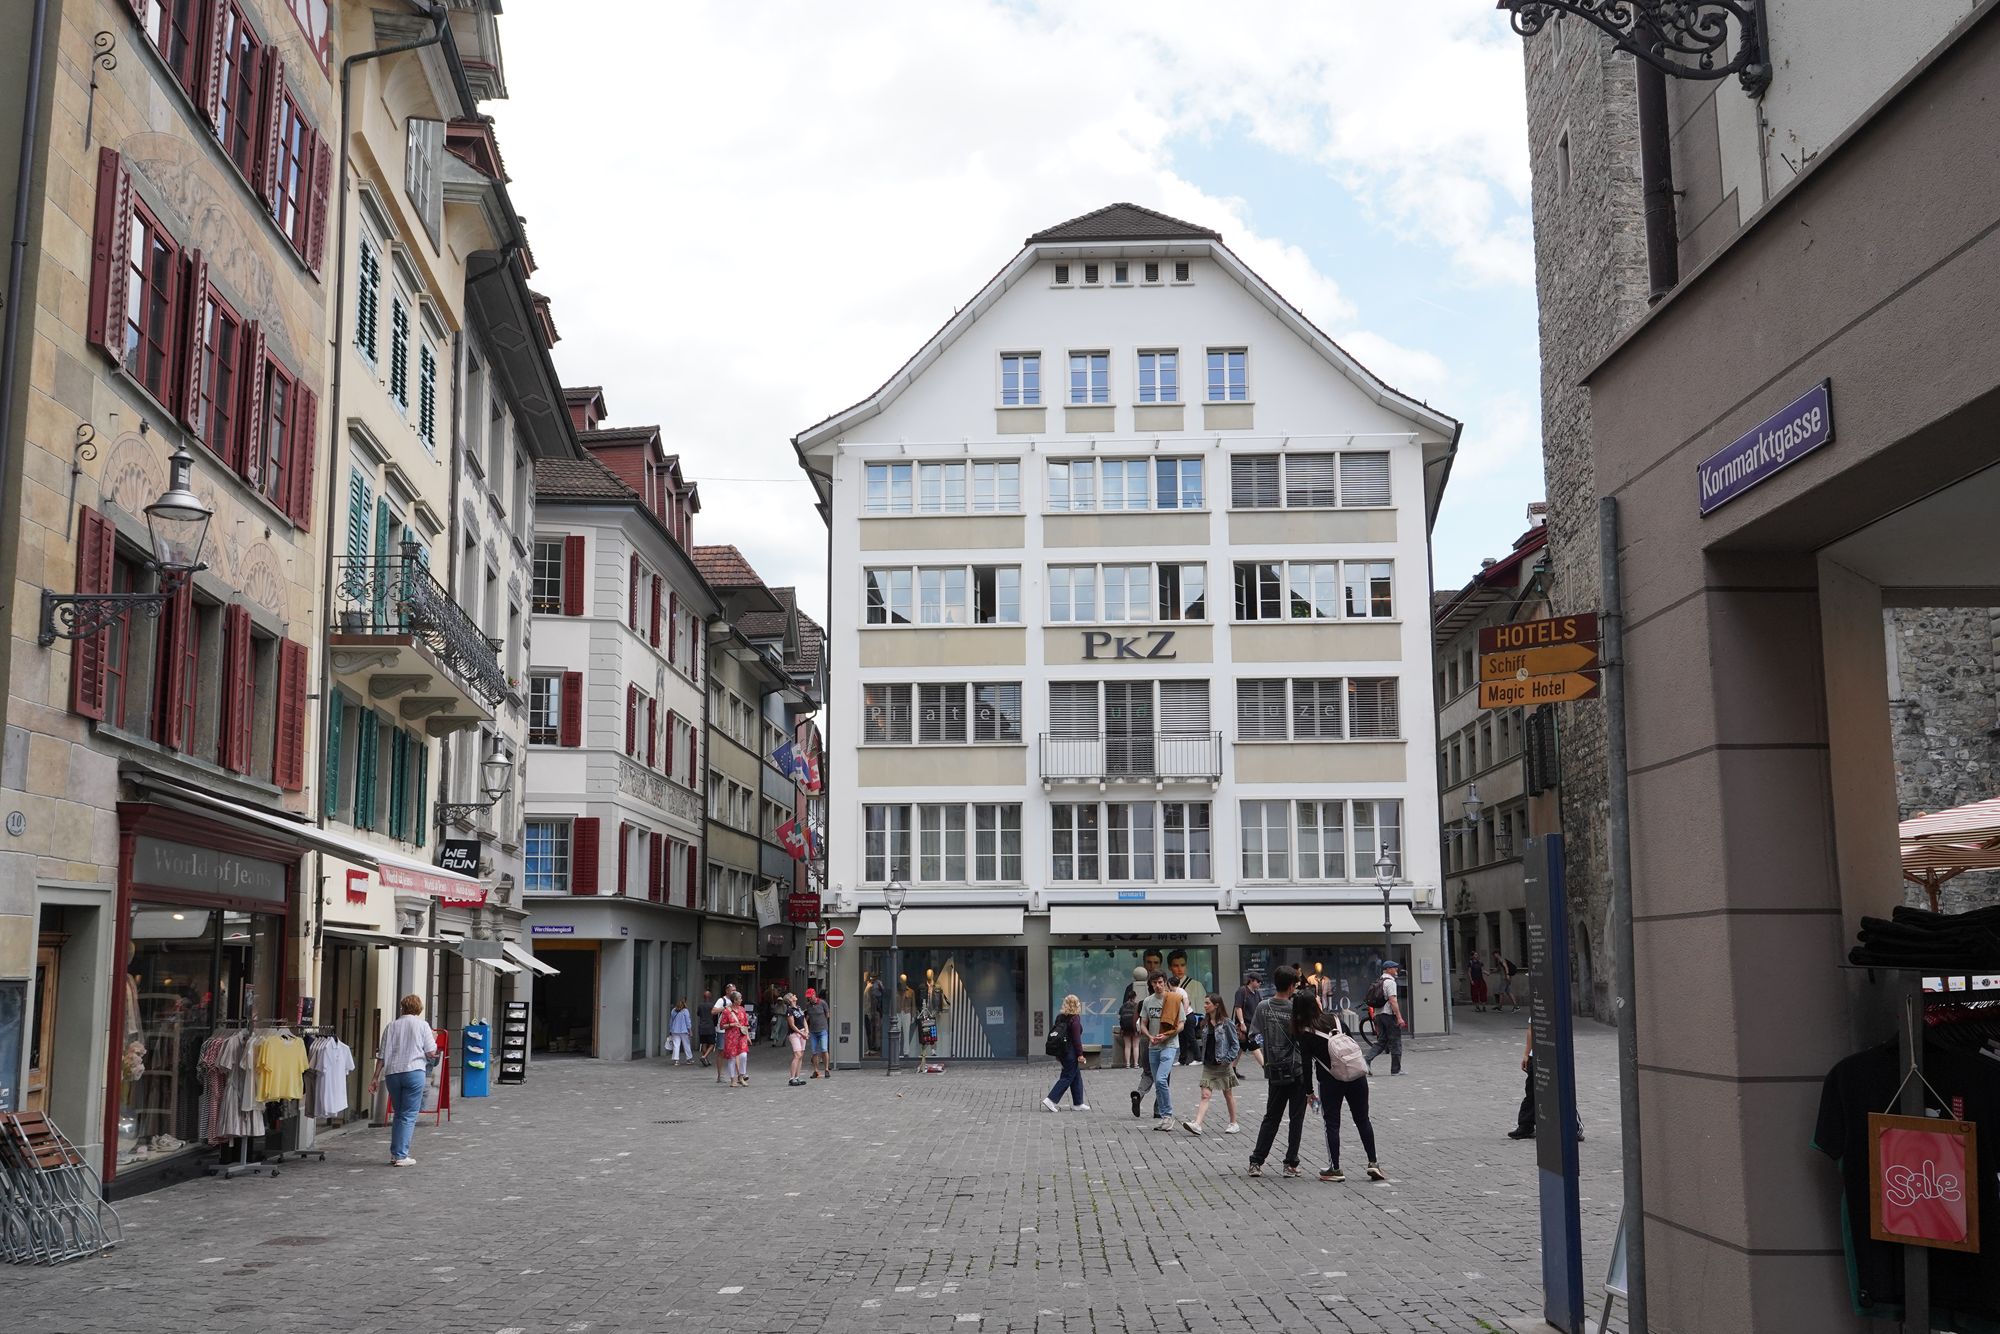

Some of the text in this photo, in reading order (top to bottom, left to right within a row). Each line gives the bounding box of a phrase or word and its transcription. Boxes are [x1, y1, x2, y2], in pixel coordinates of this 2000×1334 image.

[1702, 406, 1822, 501] Kornmarktgasse
[1081, 631, 1177, 660] PKZ
[1496, 618, 1577, 648] HOTELS
[1489, 655, 1526, 674] Schiff
[1488, 678, 1566, 703] Magic Hotel
[11, 814, 22, 827] 10
[445, 848, 468, 858] WE
[154, 847, 272, 888] World of Jeans
[987, 1009, 1003, 1017] 30%
[1079, 997, 1119, 1016] KZ
[1885, 1159, 1962, 1207] Sale
